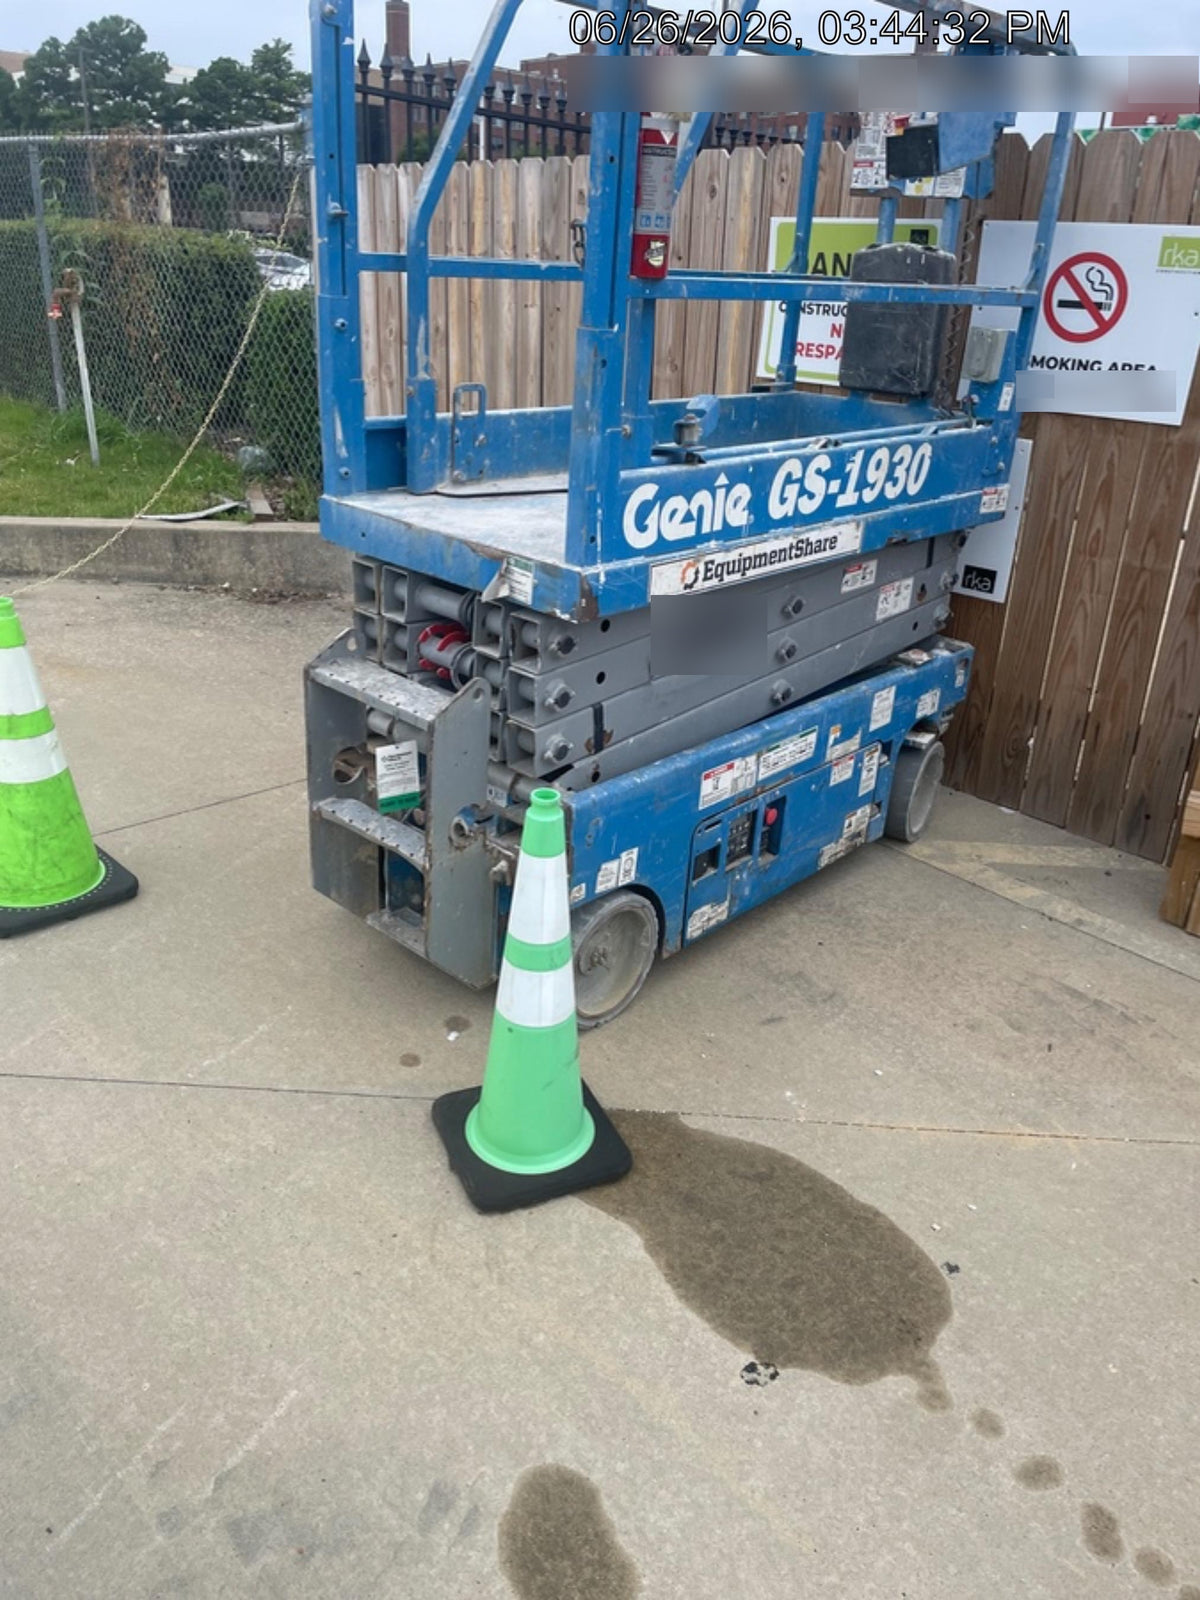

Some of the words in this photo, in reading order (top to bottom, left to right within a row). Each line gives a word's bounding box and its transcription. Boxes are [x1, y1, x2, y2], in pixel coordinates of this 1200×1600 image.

[1030, 355, 1102, 371] MOKING
[623, 472, 752, 549] Genie
[768, 442, 932, 519] GS-1930
[702, 534, 838, 582] EquipmentShare
[965, 571, 992, 591] rka
